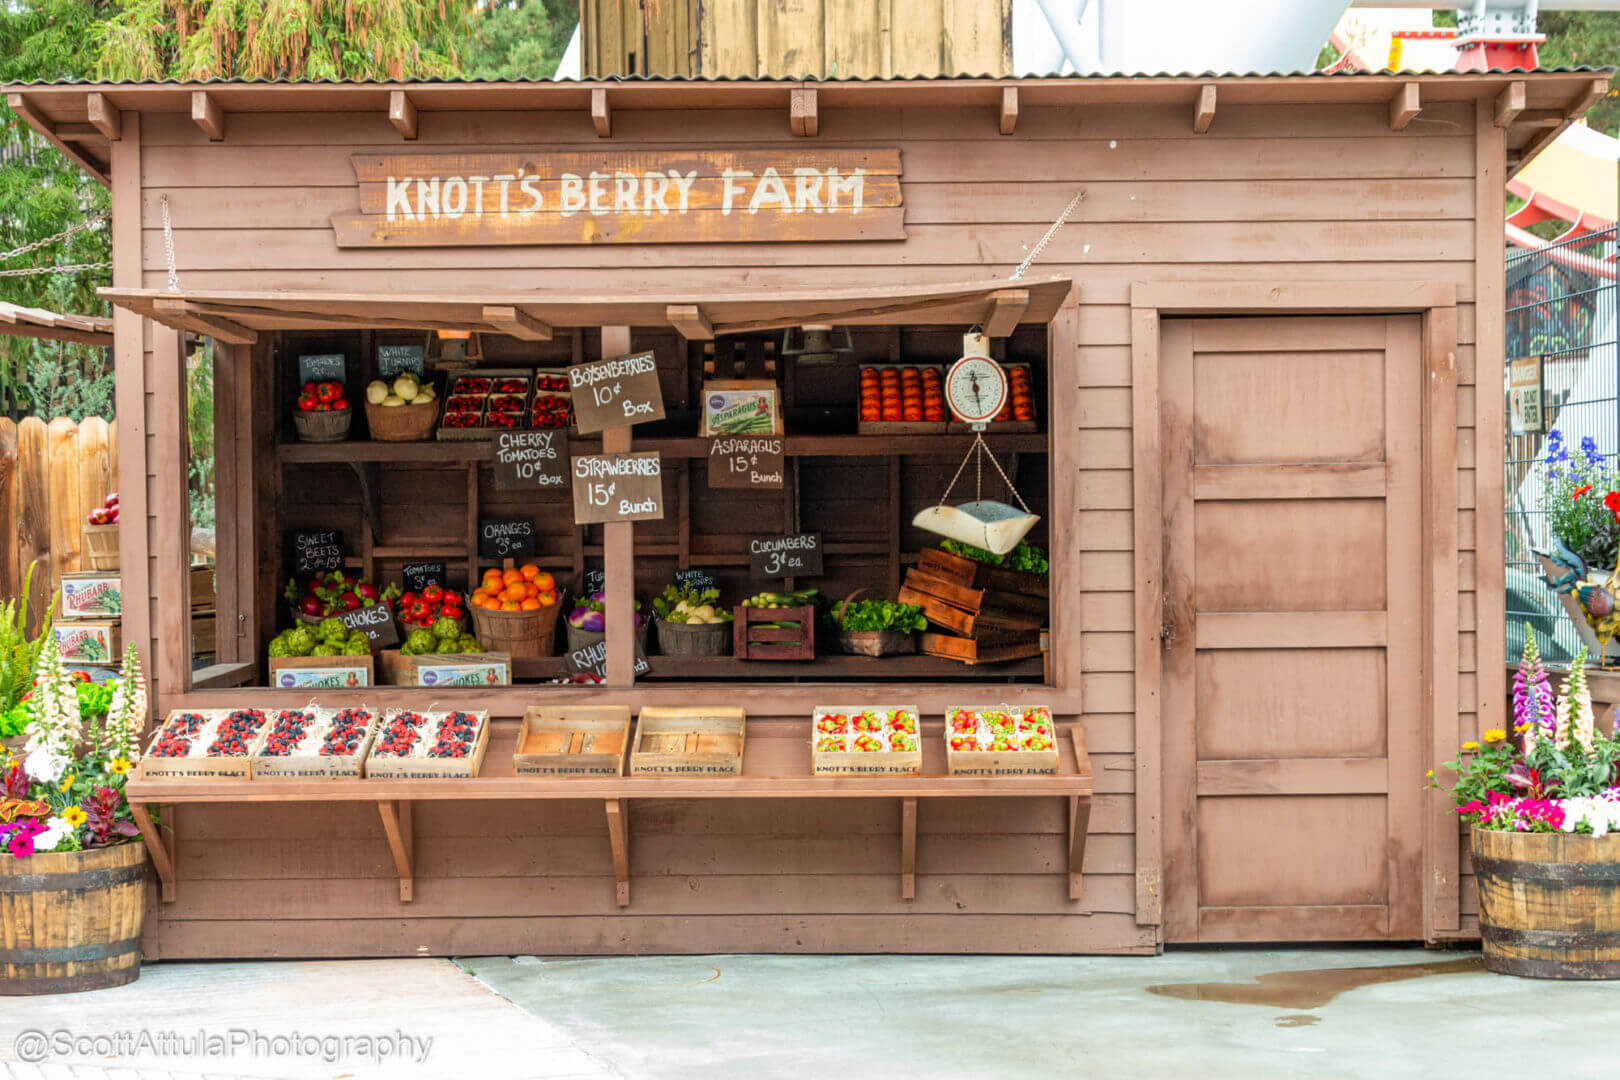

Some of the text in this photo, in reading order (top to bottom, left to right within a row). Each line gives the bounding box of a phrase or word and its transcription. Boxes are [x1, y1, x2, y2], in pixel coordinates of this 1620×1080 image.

[385, 166, 867, 222] KNOTT'S BERRY FARM
[570, 355, 655, 387] BOYSENBERRIES
[593, 382, 622, 407] 10¢
[622, 400, 654, 417] Box
[711, 400, 758, 426] ASPARAGUS
[499, 432, 554, 449] CHERRY
[710, 438, 781, 456] ASPARAGUS
[496, 447, 557, 463] TOMATOES
[729, 454, 758, 473] 15¢
[516, 461, 542, 479] 10¢
[575, 456, 660, 479] STRAWBERRIES
[750, 470, 783, 484] Bunch
[538, 473, 564, 486] Box
[588, 481, 616, 506] 15¢
[617, 496, 657, 515] Bunch
[484, 522, 531, 538] ORANGES
[297, 531, 335, 550] SWEET
[751, 535, 817, 554] CUCUMBERS
[305, 545, 339, 559] BEETS
[764, 551, 786, 574] 3¢
[66, 583, 109, 610] RHUBARB
[557, 767, 586, 775] BERRY
[589, 767, 617, 775] PLACE
